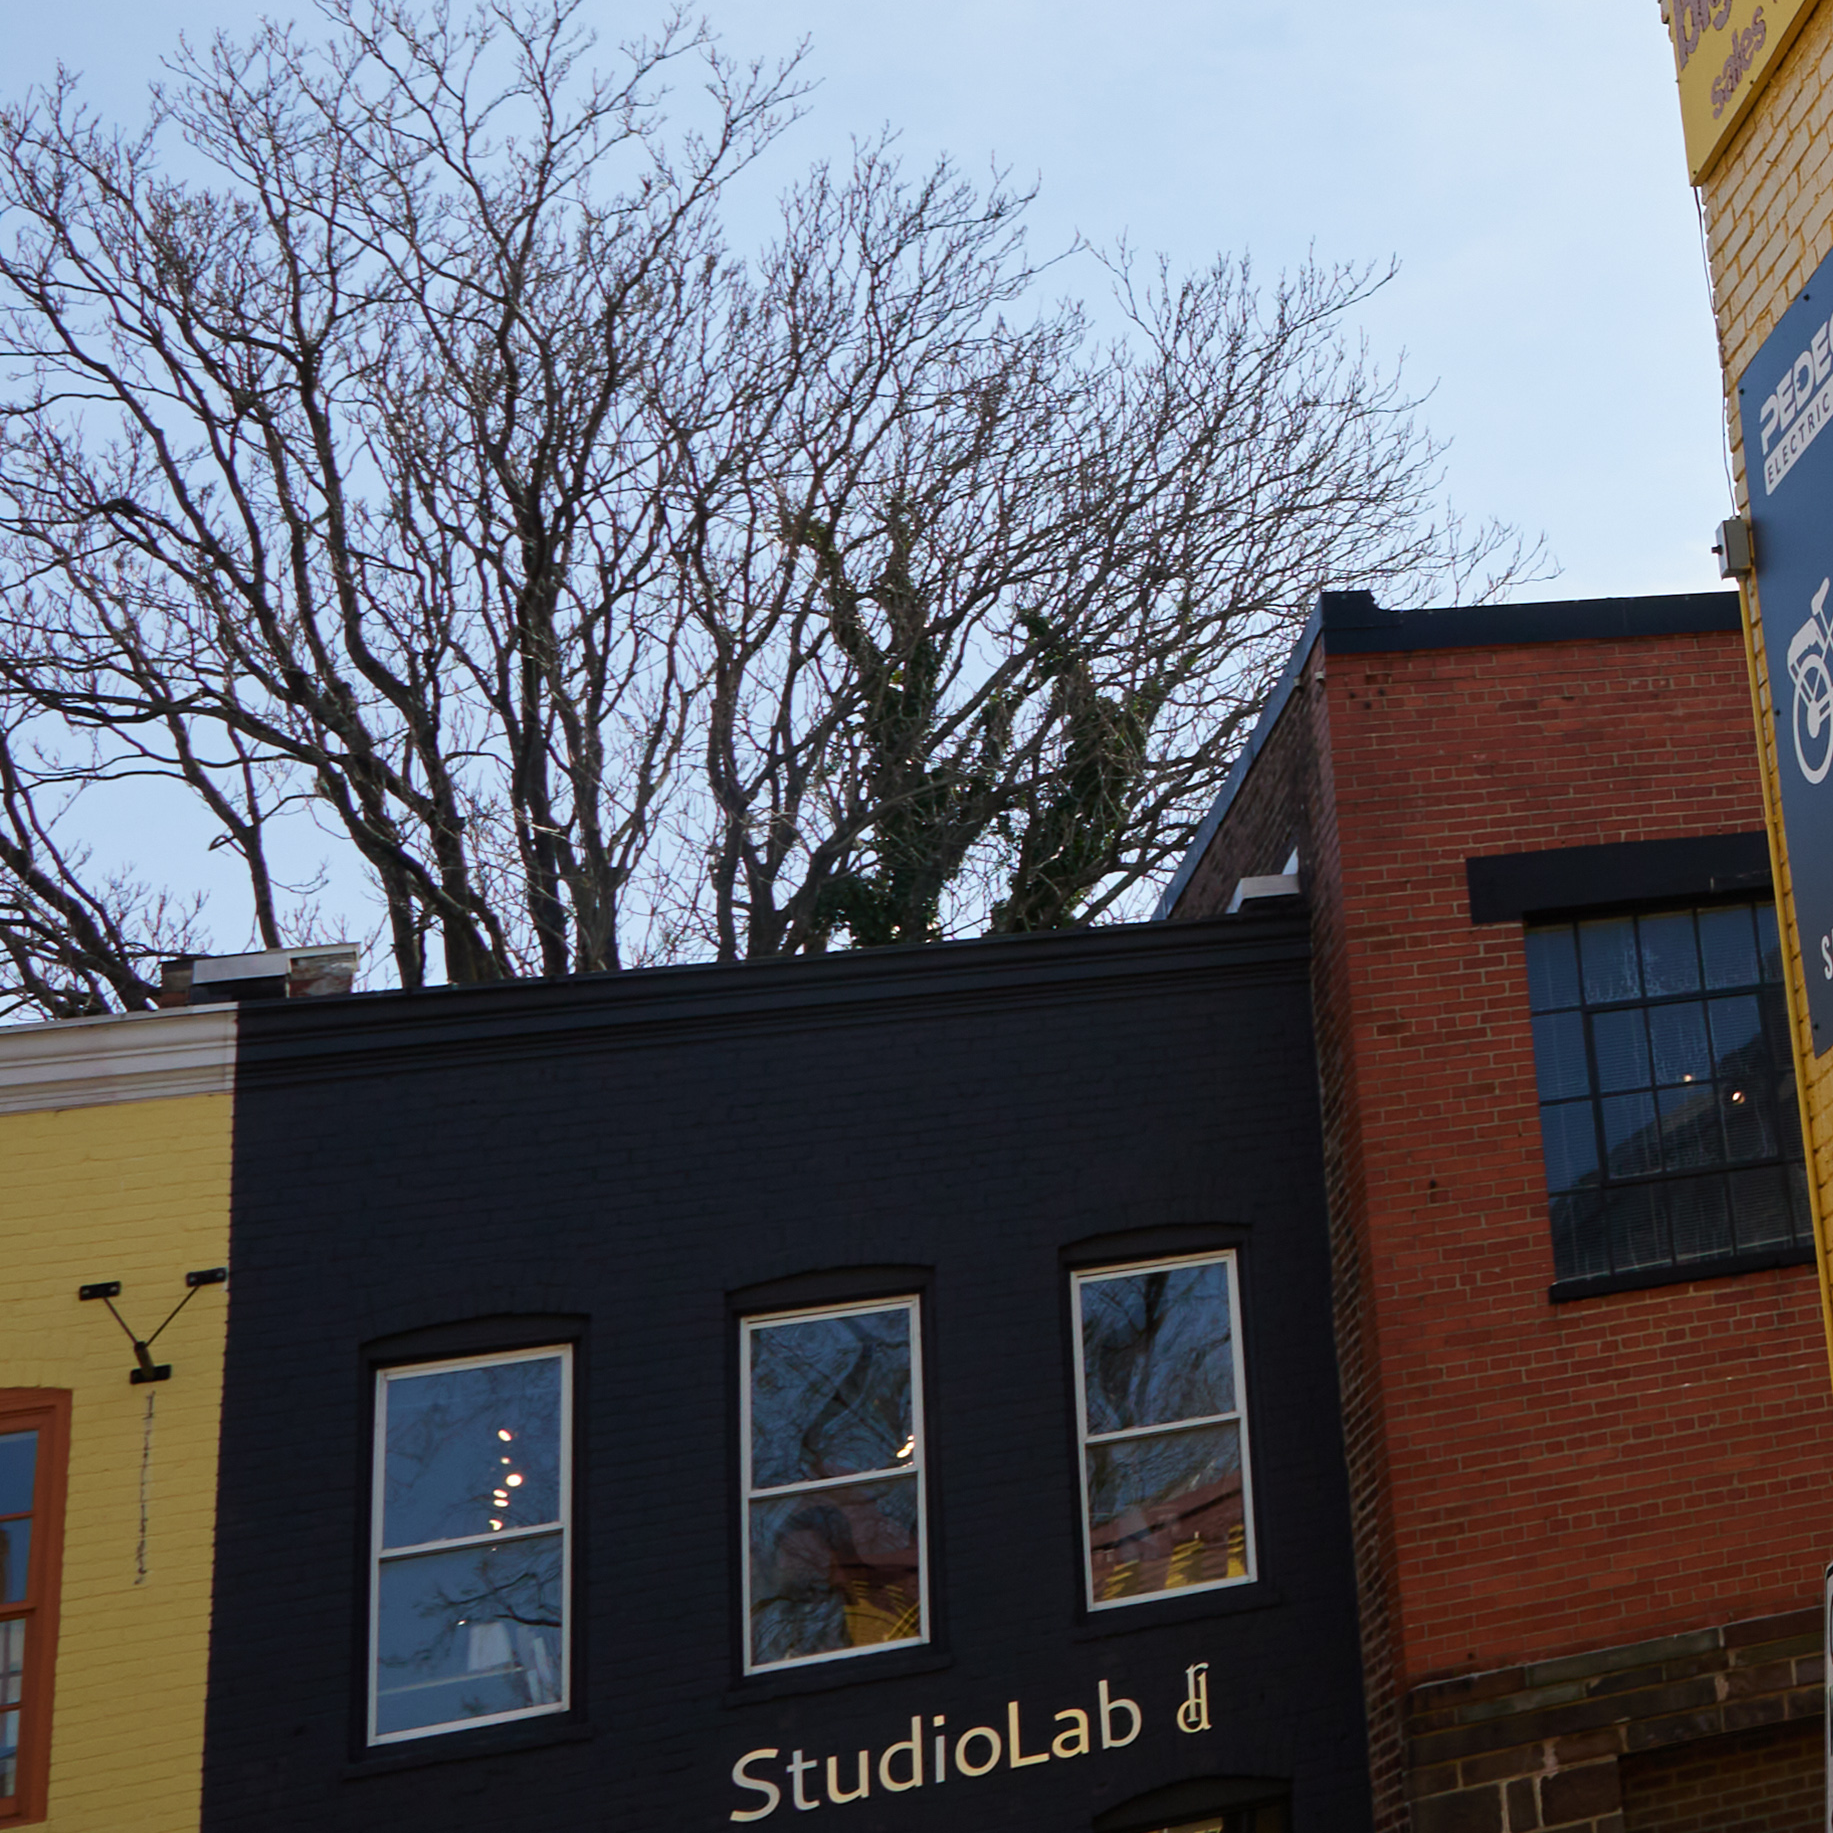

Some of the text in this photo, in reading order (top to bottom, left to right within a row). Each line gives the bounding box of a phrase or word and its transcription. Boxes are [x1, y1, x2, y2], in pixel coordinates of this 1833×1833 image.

[1710, 5, 1767, 120] sales
[1767, 392, 1830, 485] ELECTRIC
[730, 1680, 1142, 1822] StudioLab
